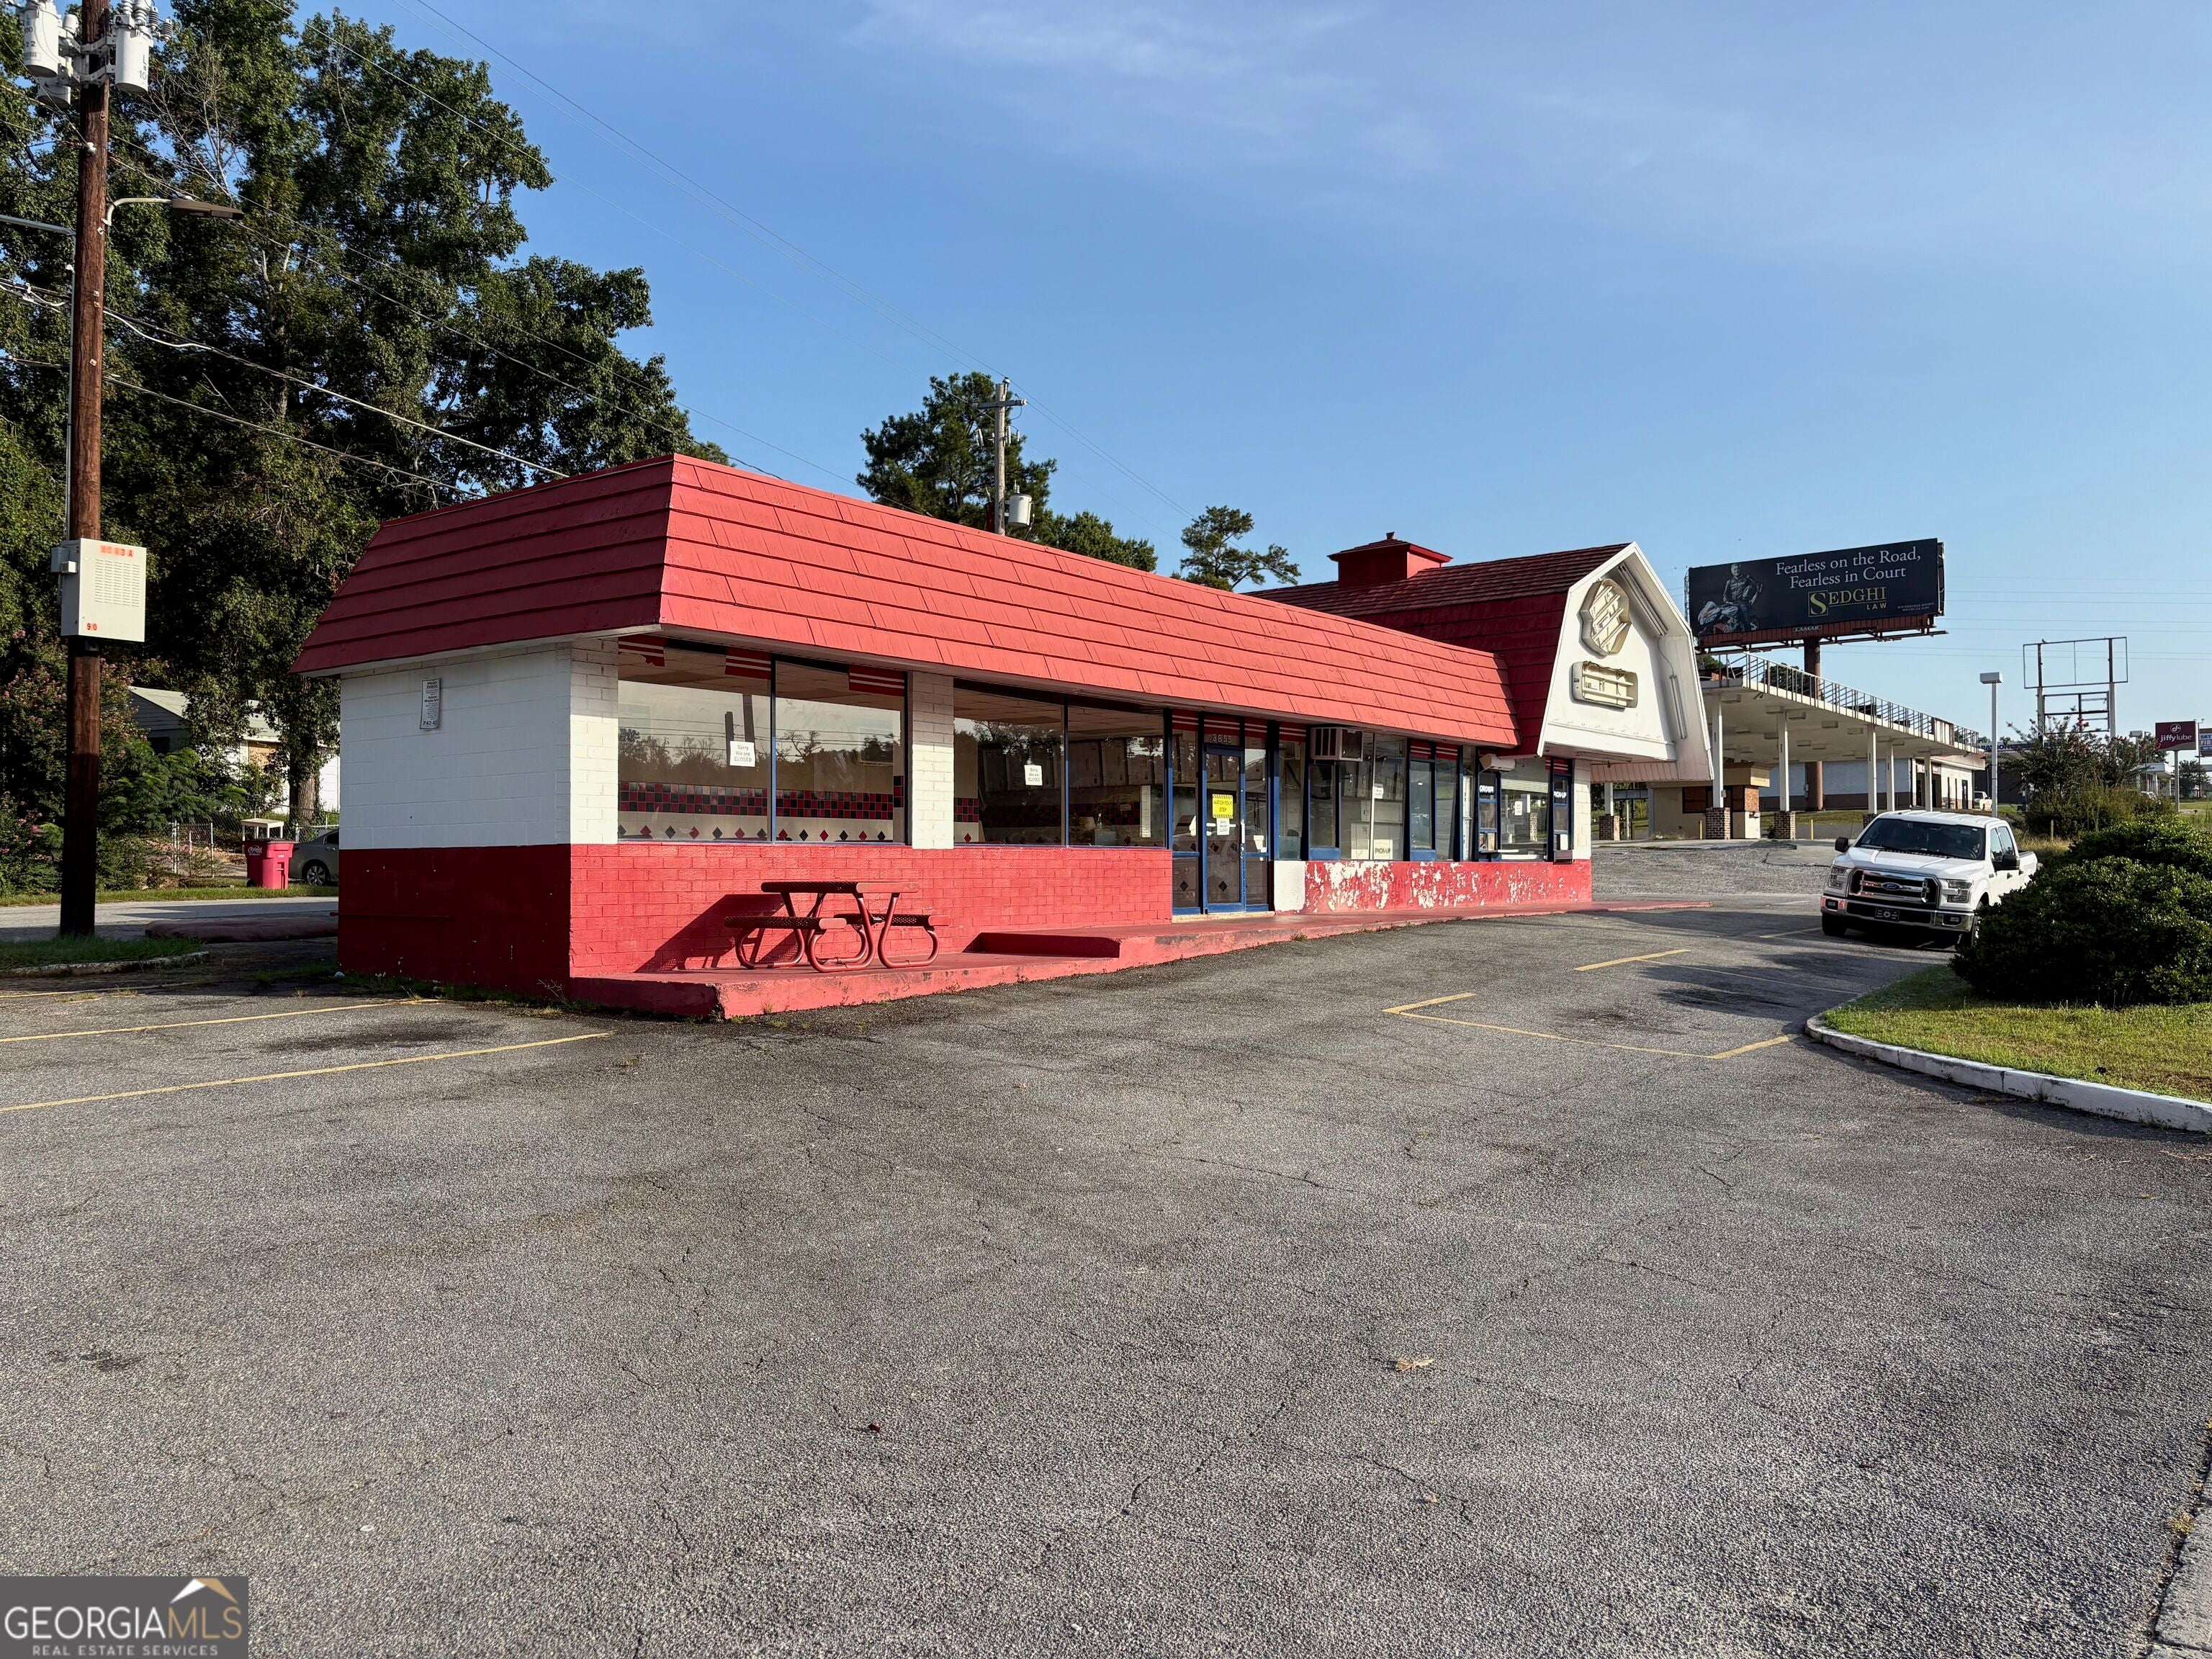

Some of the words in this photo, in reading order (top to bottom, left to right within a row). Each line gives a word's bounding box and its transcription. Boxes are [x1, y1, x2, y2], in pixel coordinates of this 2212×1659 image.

[1776, 559, 1826, 575] Fearless
[1830, 559, 1848, 569] on
[1853, 552, 1875, 566] the
[1879, 546, 1921, 563] Road,
[1790, 572, 1840, 589] Fearless
[1845, 570, 1858, 583] in
[1863, 567, 1907, 580] Court
[1809, 587, 1887, 615] SEDGHI
[2160, 734, 2176, 743] jiffy
[1479, 784, 1494, 793] ORDER
